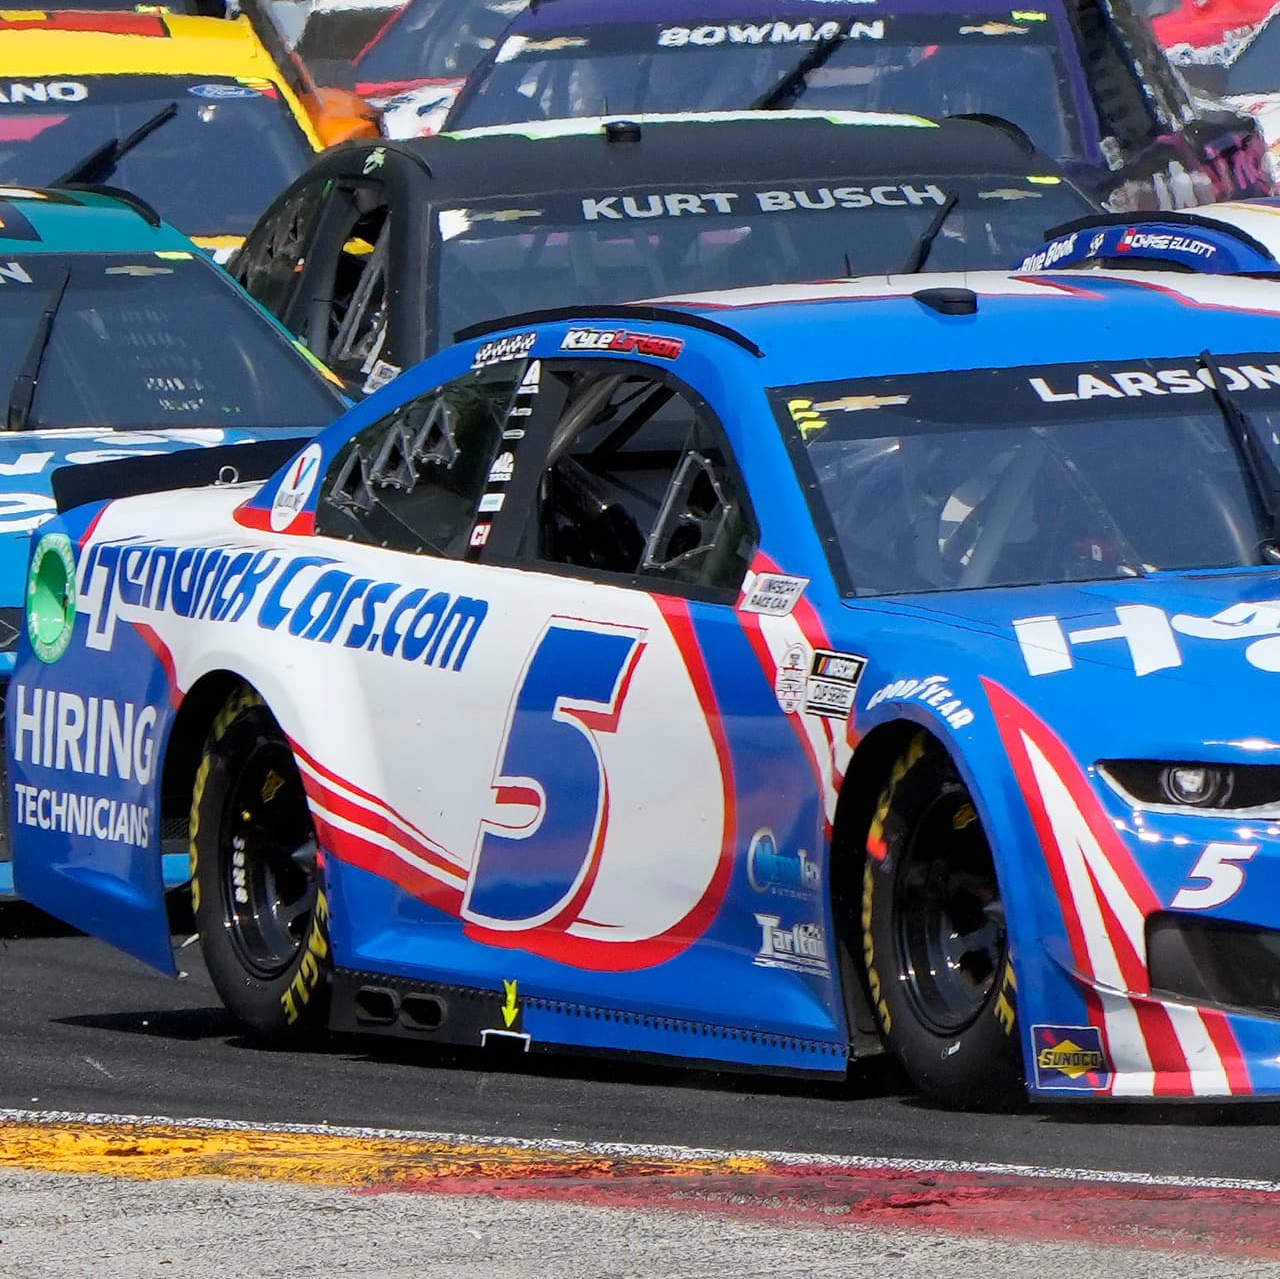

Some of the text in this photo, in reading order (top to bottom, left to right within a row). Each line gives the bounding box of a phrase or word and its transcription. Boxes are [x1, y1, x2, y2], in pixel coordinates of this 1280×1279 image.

[658, 20, 884, 47] BOWMAN
[581, 184, 947, 221] KURT BUSCH
[866, 675, 975, 730] GOODYEAR
[14, 684, 158, 786] HIRING
[461, 615, 650, 934] 5
[14, 783, 150, 849] TECHNICIANS
[1170, 842, 1259, 910] 5
[1042, 1051, 1101, 1069] SUNOCO
